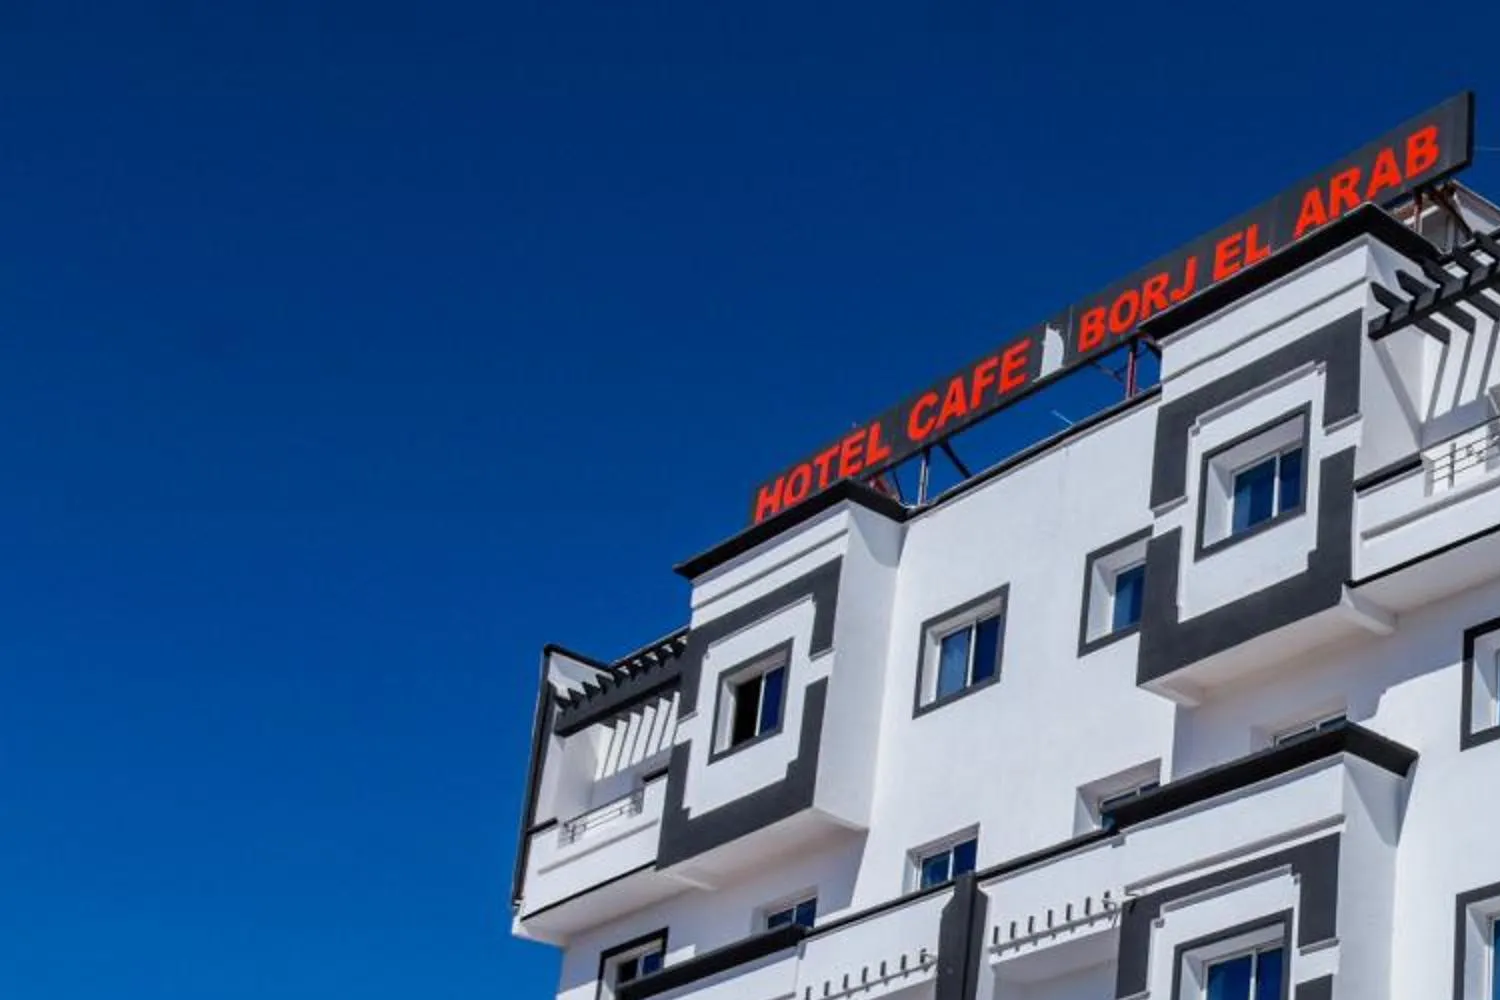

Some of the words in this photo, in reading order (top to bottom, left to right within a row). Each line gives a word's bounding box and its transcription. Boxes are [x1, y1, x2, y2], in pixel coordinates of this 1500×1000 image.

[755, 421, 891, 525] HOTEL
[907, 338, 1032, 441] CAFE
[1078, 255, 1197, 352] BORJ
[1213, 223, 1270, 282] EL
[1293, 124, 1440, 238] ARAB
